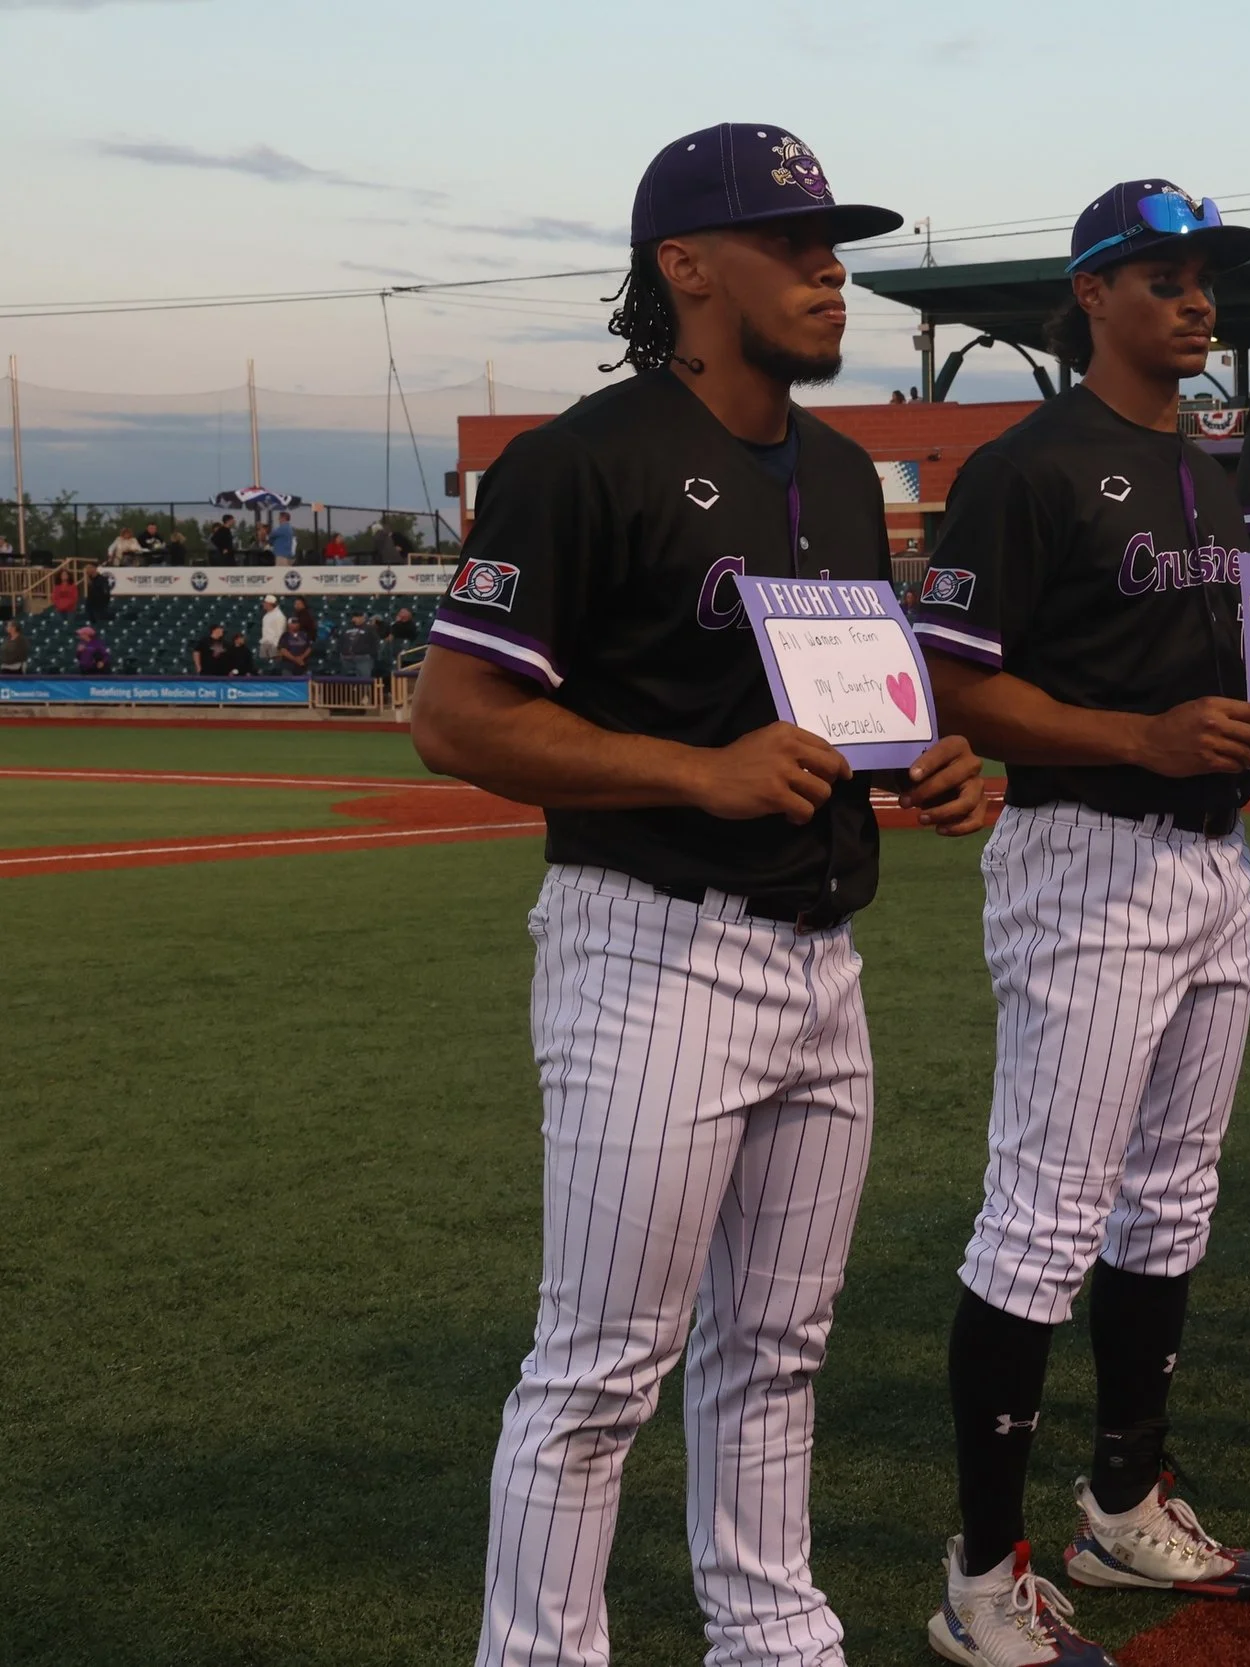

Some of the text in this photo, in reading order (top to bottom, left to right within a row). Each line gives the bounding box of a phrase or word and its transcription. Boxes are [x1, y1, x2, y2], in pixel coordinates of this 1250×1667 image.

[1117, 531, 1242, 596] Crushe
[133, 575, 174, 585] FORT HOPE
[226, 575, 267, 585] FORT HOPE
[320, 574, 361, 584] FORT HOPE
[415, 574, 454, 584] FORT HOP
[756, 582, 774, 615] I
[770, 583, 841, 616] FIGHT
[836, 586, 887, 616] FOR
[778, 626, 879, 651] All Women From
[837, 671, 885, 705] Country
[818, 713, 886, 738] Venezuela
